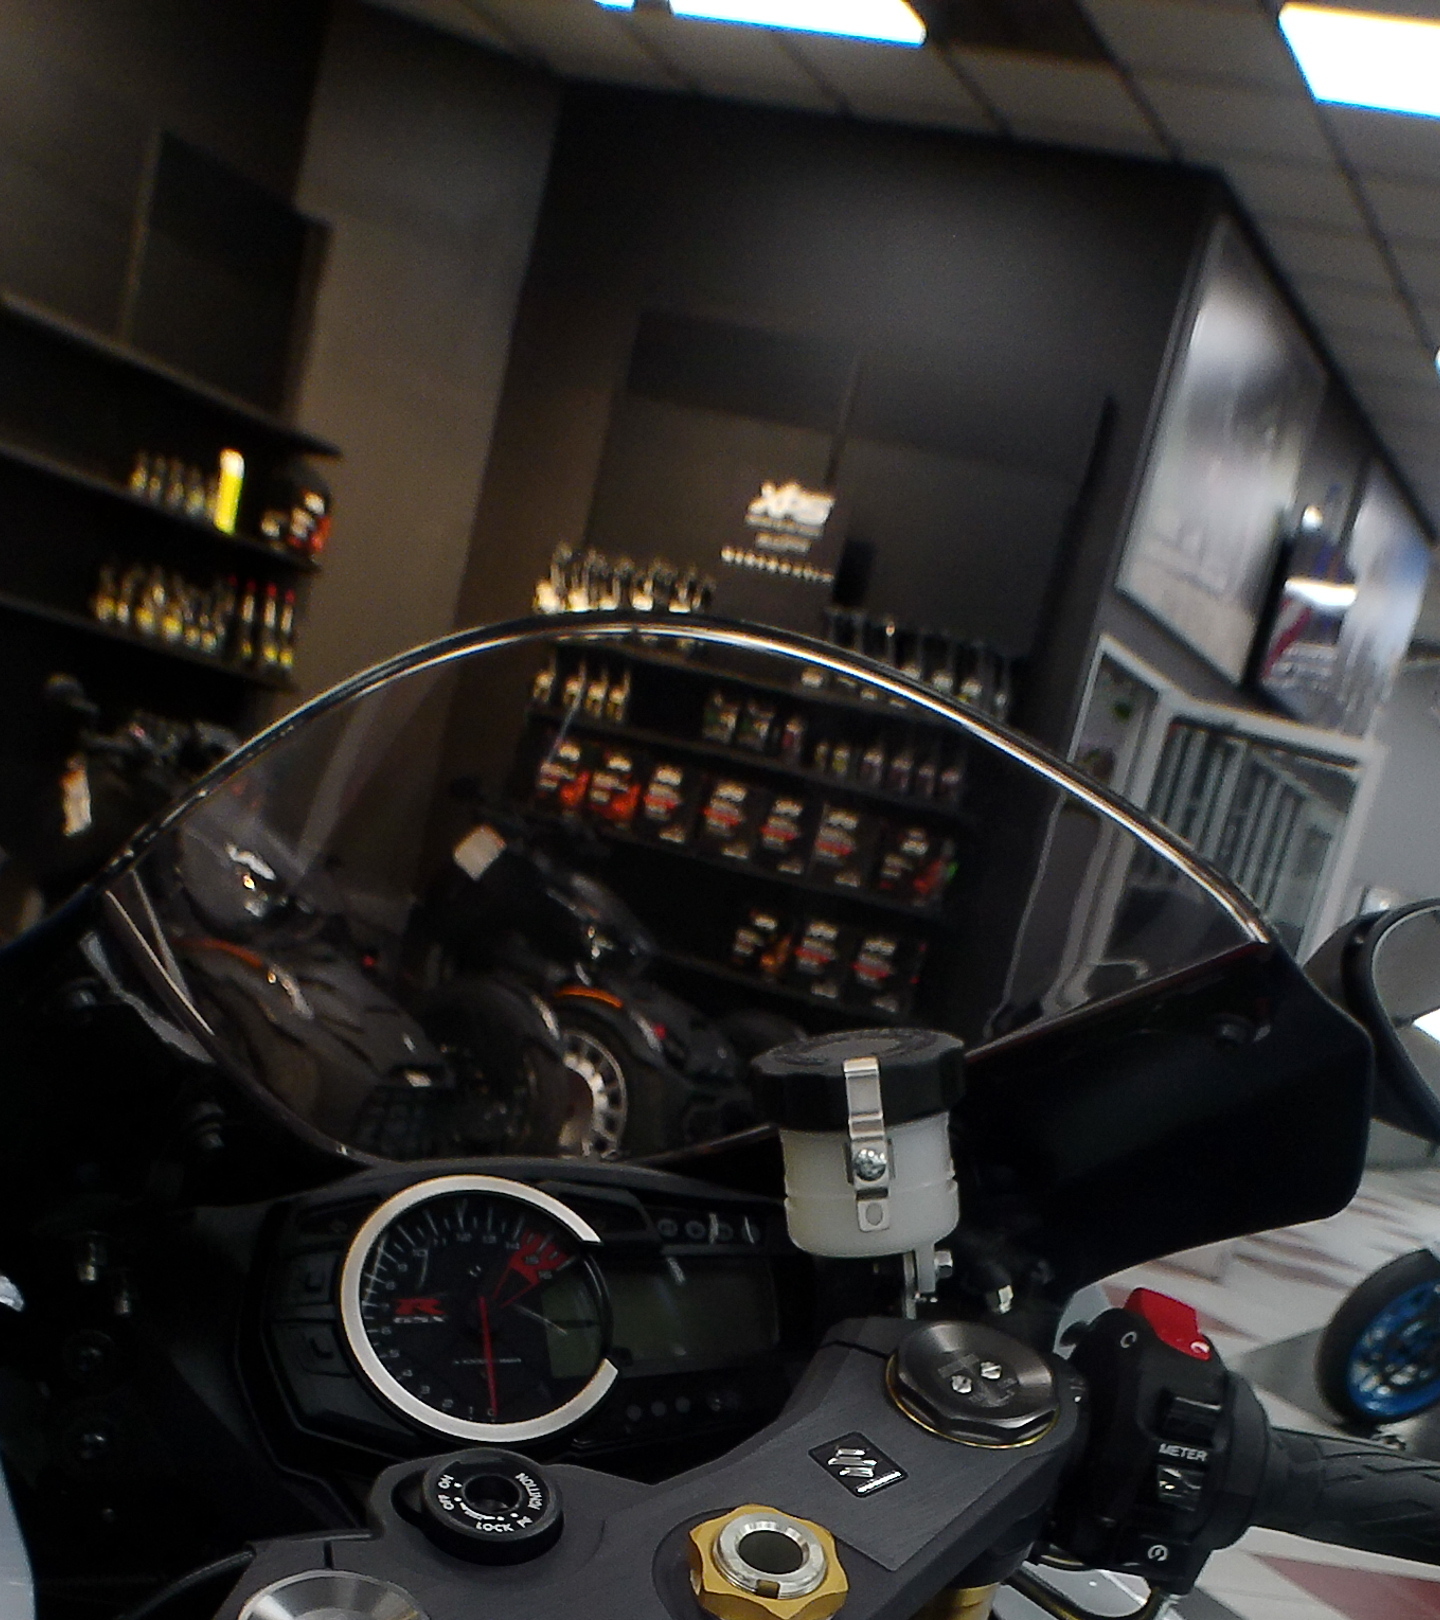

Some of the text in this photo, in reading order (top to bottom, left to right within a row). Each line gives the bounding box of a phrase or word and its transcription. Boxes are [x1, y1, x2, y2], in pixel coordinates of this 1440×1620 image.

[1158, 1443, 1208, 1462] METER
[437, 1474, 455, 1490] ON
[475, 1521, 515, 1533] LOCK
